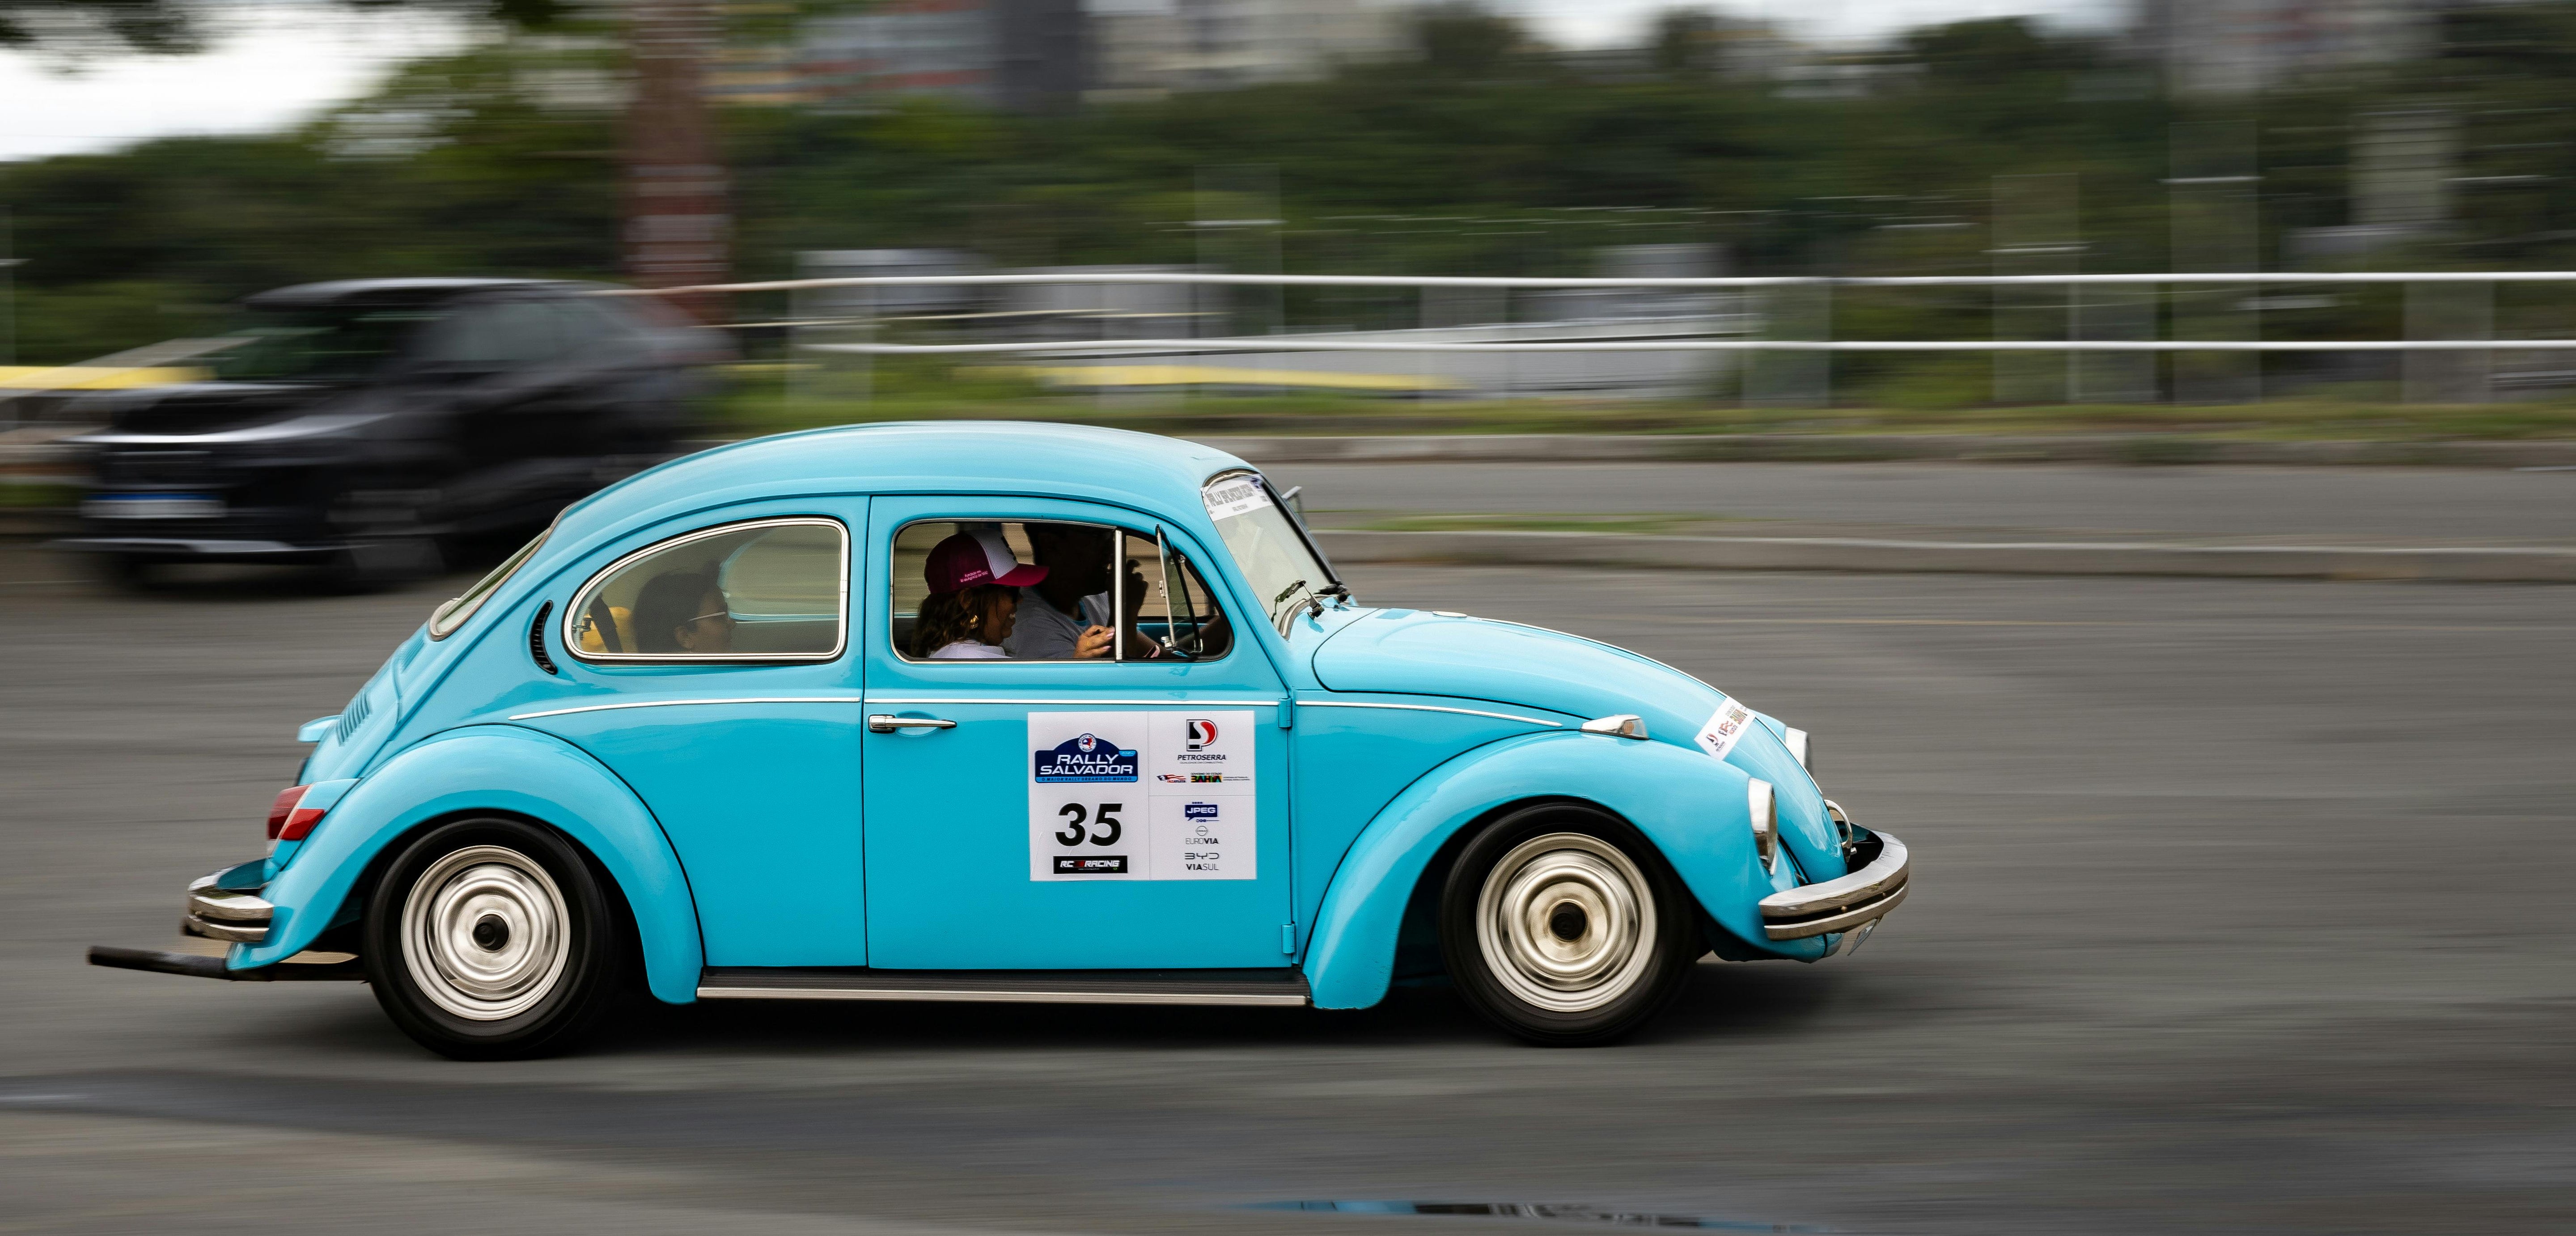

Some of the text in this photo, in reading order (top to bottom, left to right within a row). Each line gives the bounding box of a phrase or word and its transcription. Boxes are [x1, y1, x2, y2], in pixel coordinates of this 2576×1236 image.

[1057, 754, 1119, 764] RALLY
[1040, 765, 1133, 775] SALVADOR
[1055, 803, 1123, 846] 35
